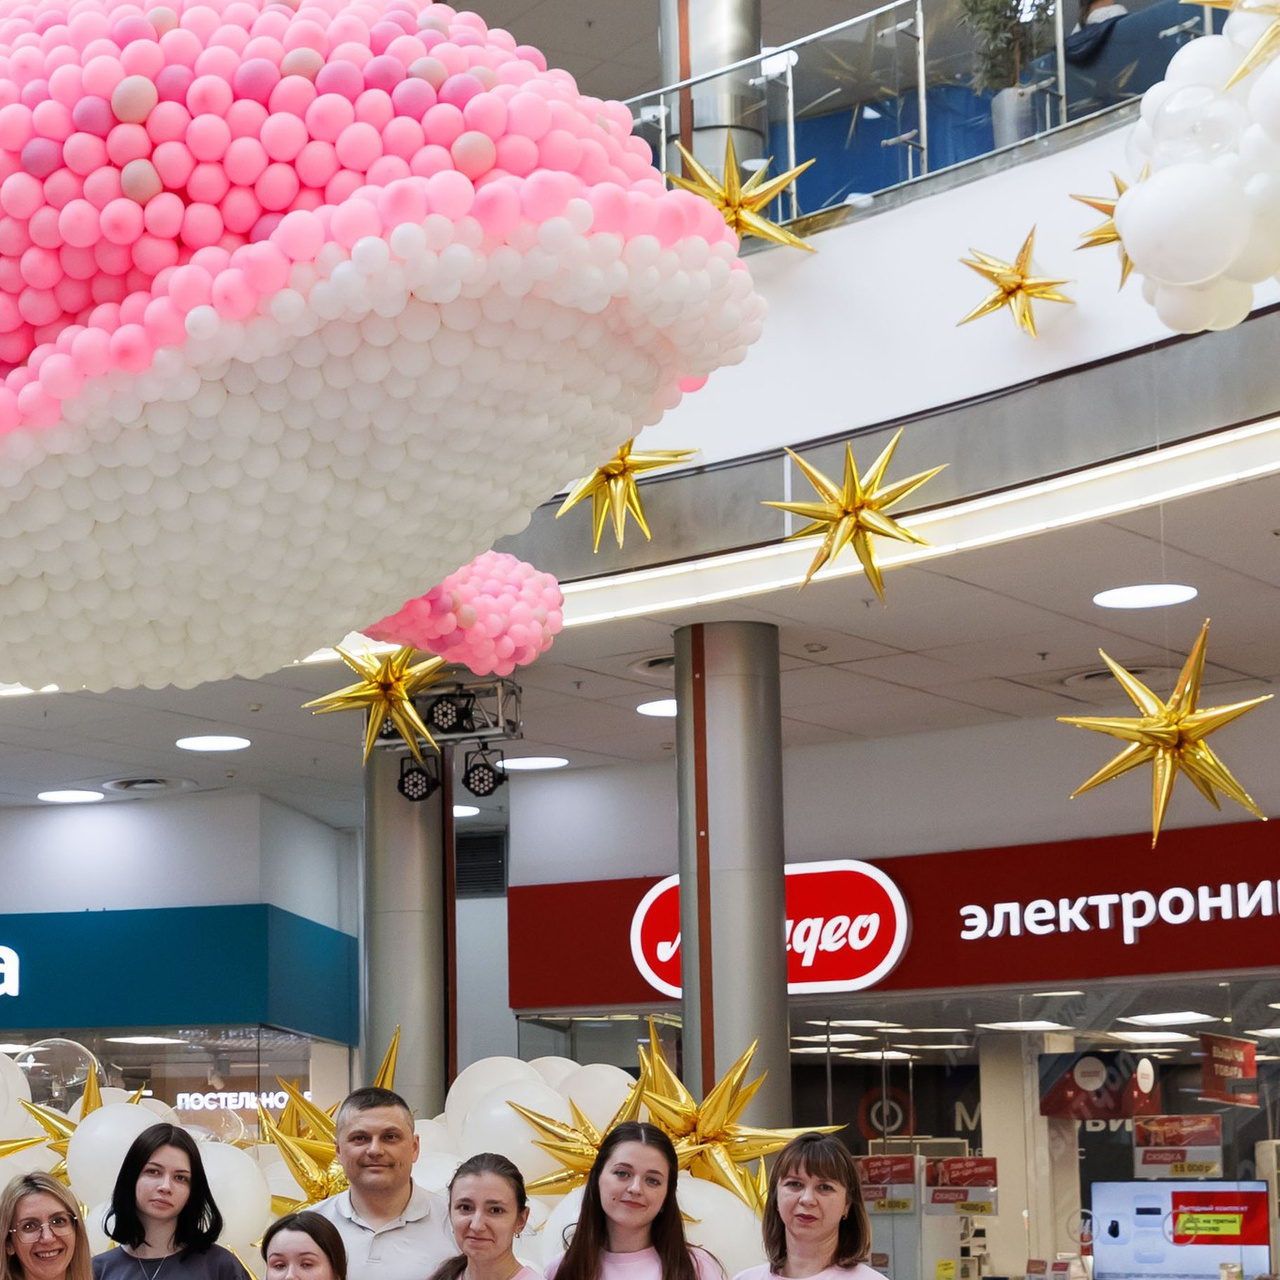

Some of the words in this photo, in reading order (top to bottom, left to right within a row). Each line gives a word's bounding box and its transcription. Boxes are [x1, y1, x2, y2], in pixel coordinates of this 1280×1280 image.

[959, 878, 1280, 945] электрони
[177, 1091, 290, 1111] ПОСТЕЛЬНО
[1145, 1151, 1182, 1161] СКИДКА
[933, 1190, 965, 1201] СКИДКА
